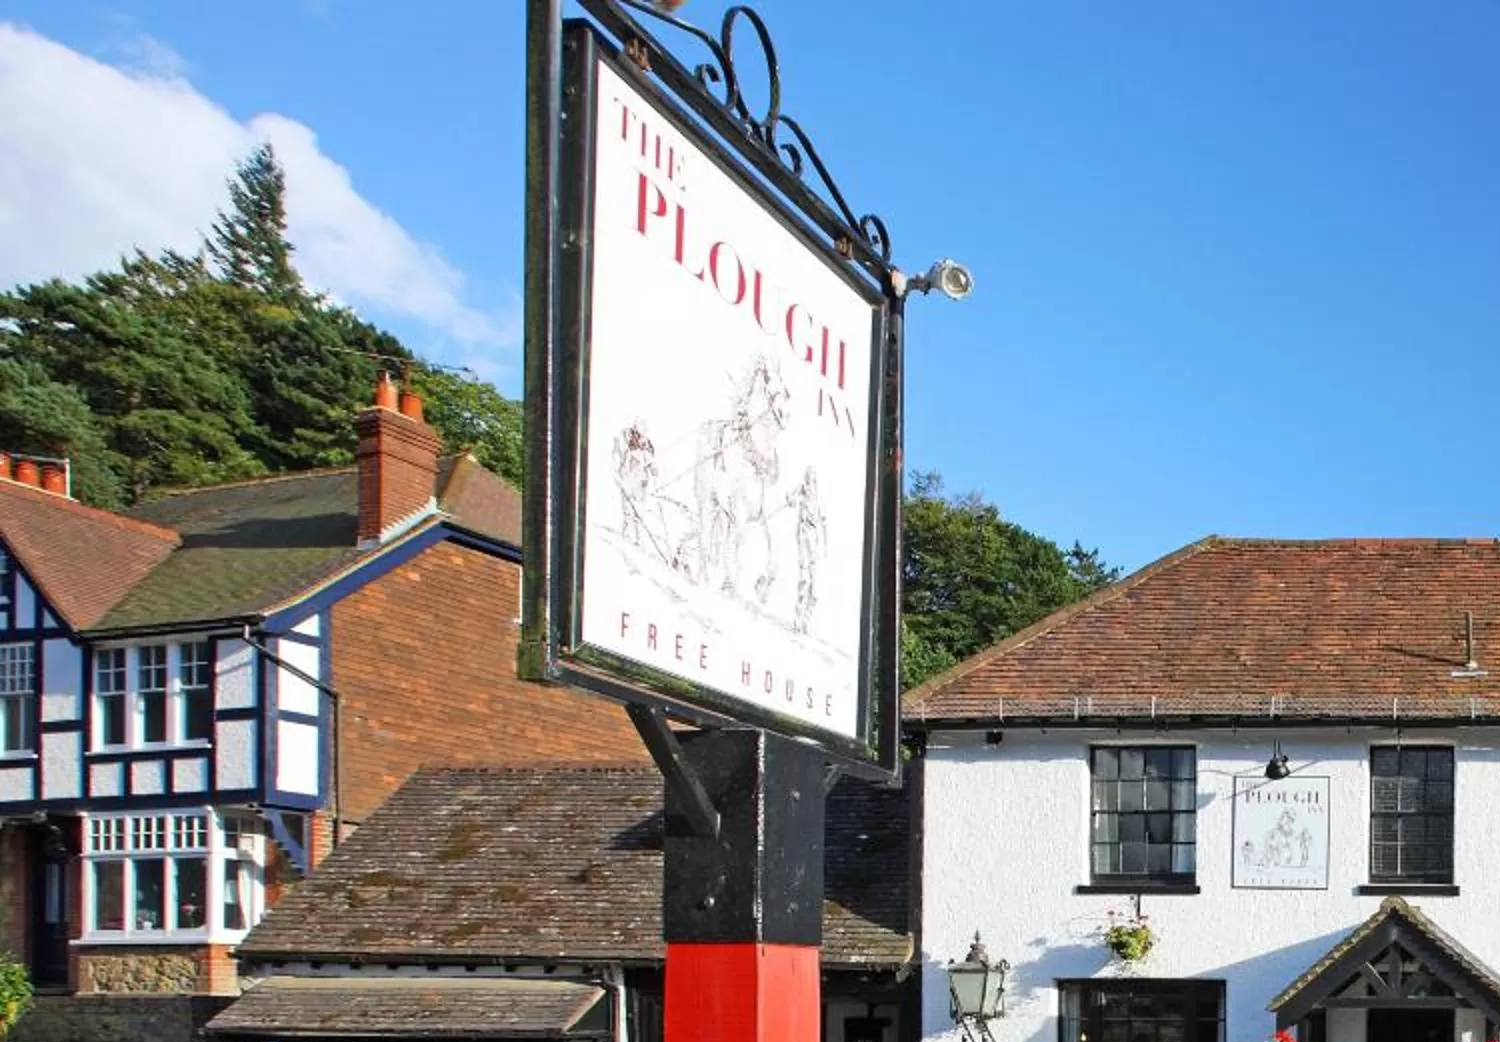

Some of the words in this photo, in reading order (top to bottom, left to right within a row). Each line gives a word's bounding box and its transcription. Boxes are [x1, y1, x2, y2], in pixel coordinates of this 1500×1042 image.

[613, 97, 687, 192] THE
[629, 168, 847, 391] PLOUGH
[817, 387, 857, 439] INN
[620, 612, 708, 670] FREE
[741, 660, 833, 717] HOUSE
[1245, 791, 1319, 804] PLOUGH
